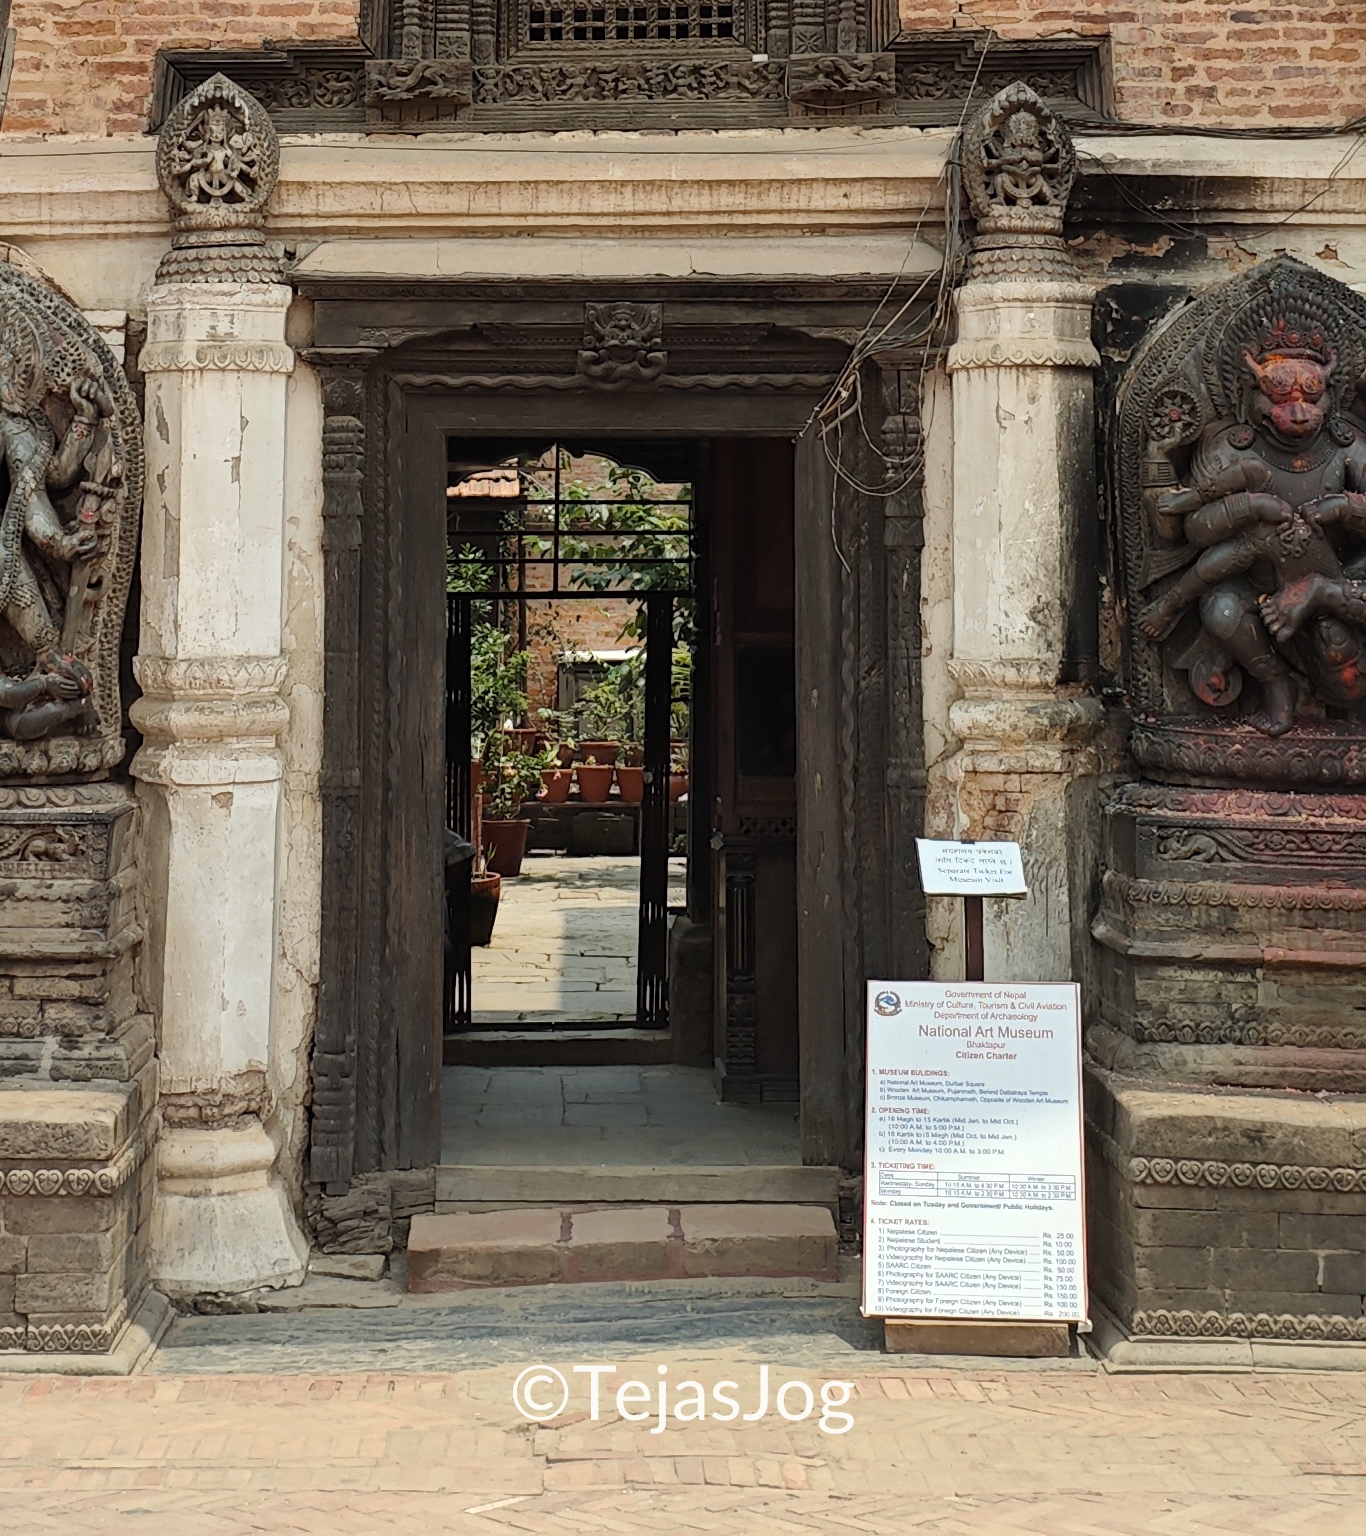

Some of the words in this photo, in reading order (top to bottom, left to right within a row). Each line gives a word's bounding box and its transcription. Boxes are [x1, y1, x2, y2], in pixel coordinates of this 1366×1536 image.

[945, 990, 992, 999] Government
[994, 991, 1002, 999] of
[1004, 991, 1026, 1001] Nepal
[904, 999, 934, 1010] Ministry
[937, 1000, 944, 1009] of
[978, 1001, 1008, 1010] Tourism
[1010, 1002, 1016, 1010] &
[1018, 1002, 1034, 1010] Civil
[1036, 1002, 1067, 1011] Aviation
[934, 1011, 979, 1021] Department
[981, 1012, 988, 1020] of
[990, 1012, 1038, 1023] Archaeology
[918, 1024, 972, 1038] National
[974, 1025, 994, 1039] Art
[998, 1025, 1054, 1040] Museum
[955, 1051, 984, 1060] Citizen
[986, 1051, 1017, 1060] Charter
[878, 1068, 909, 1076] MUSEUM
